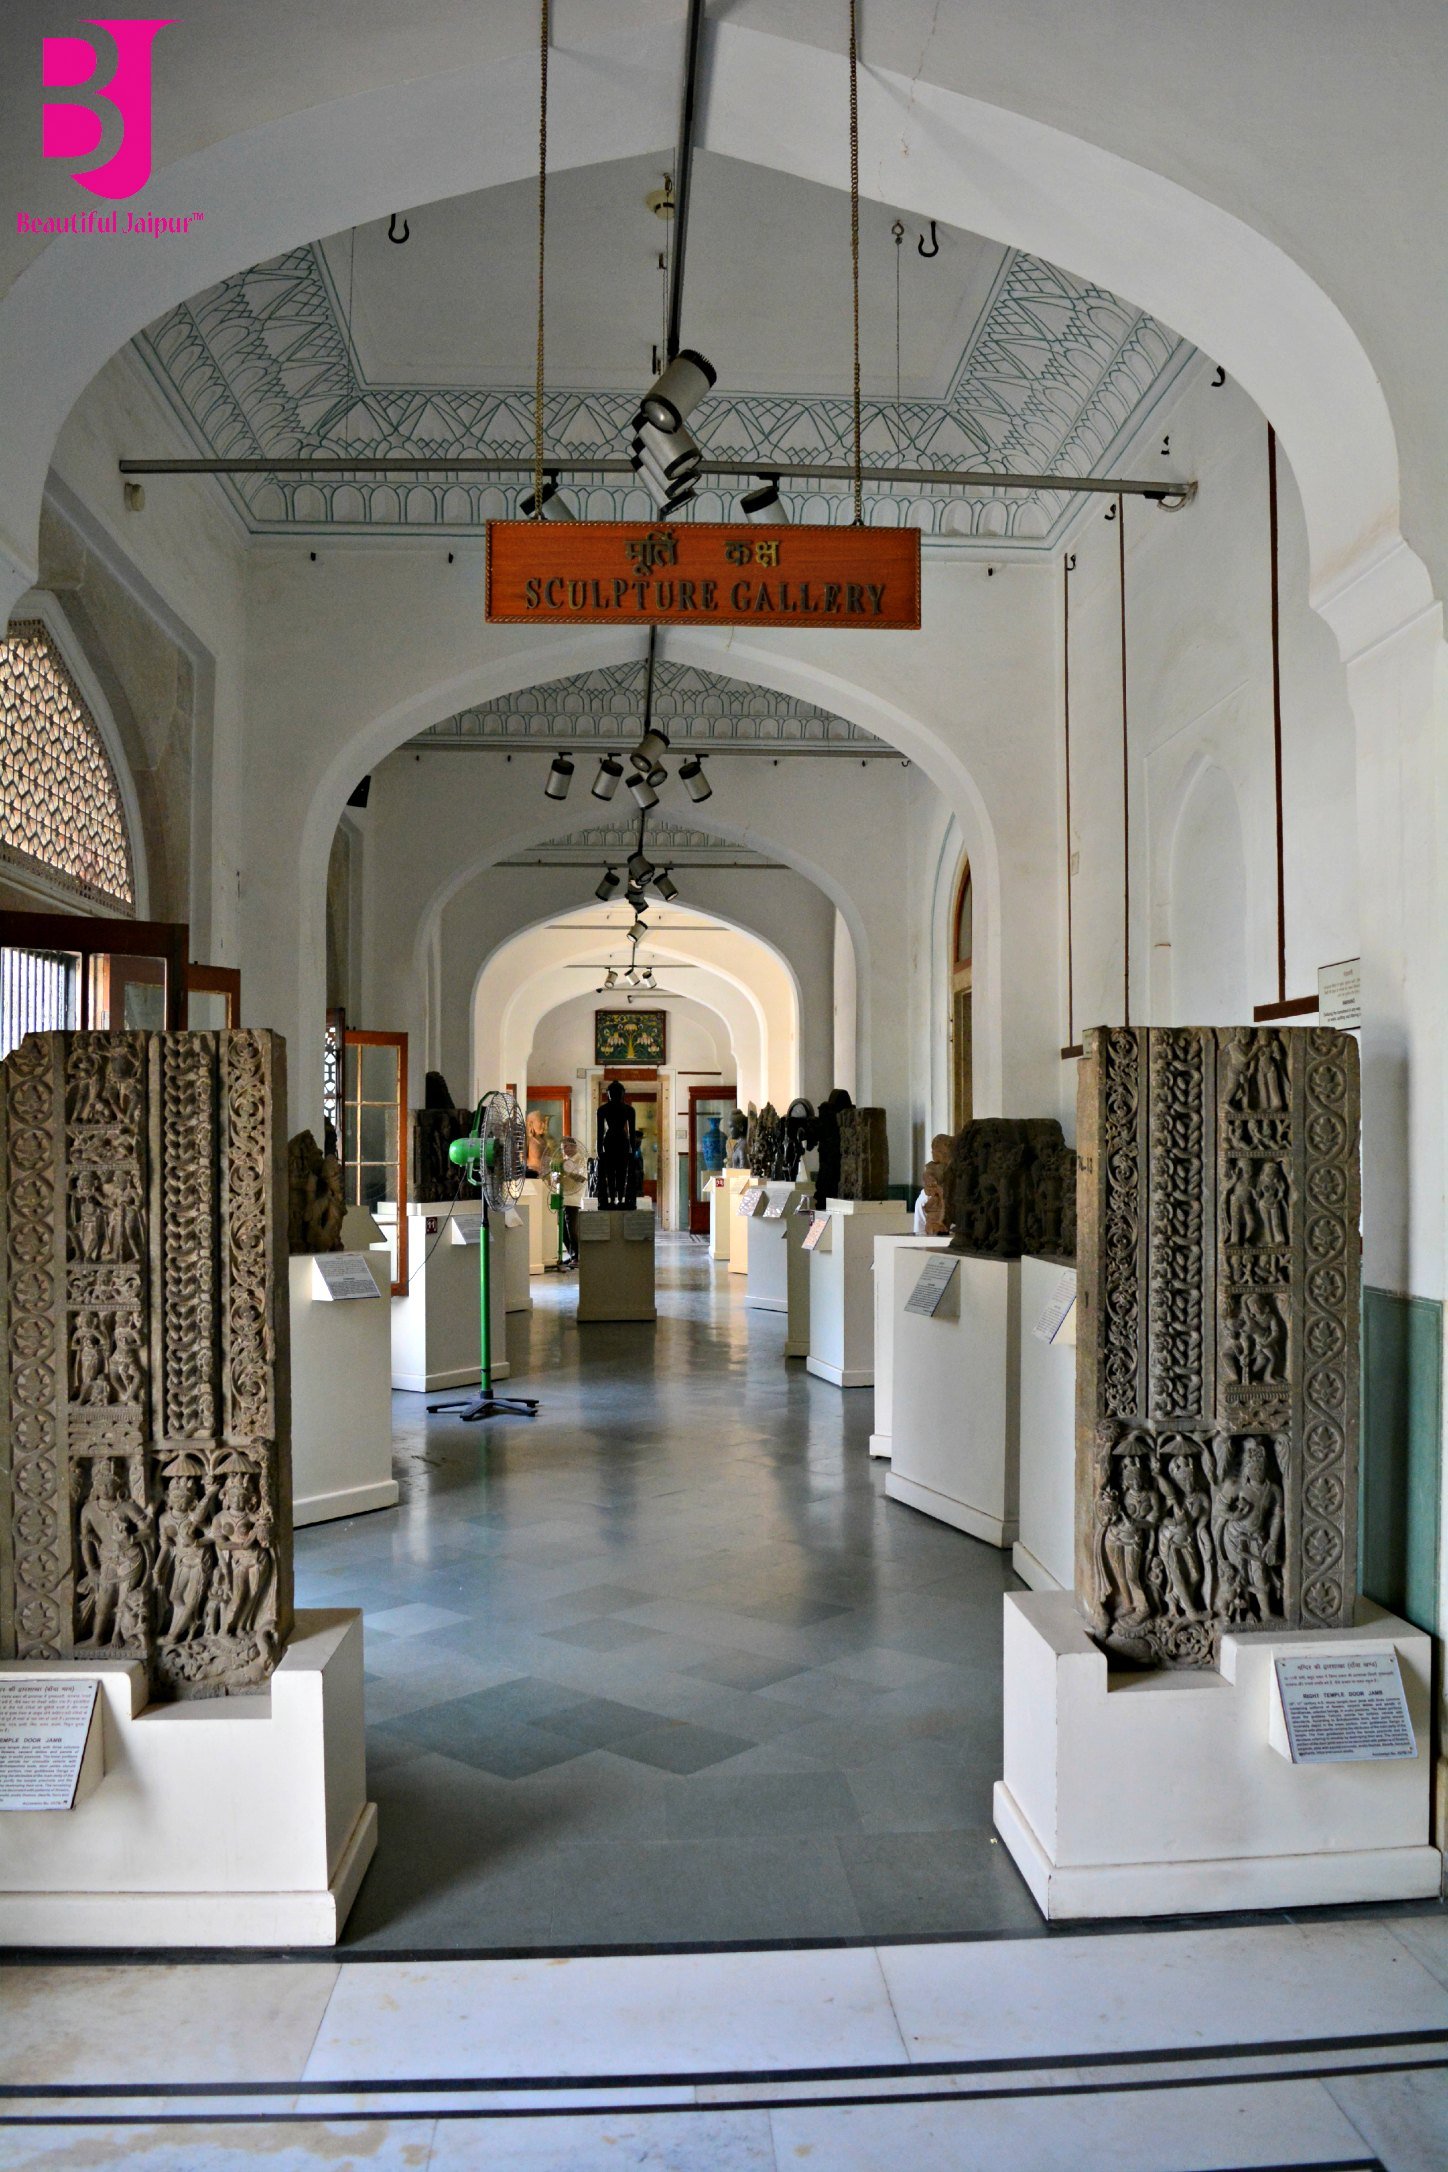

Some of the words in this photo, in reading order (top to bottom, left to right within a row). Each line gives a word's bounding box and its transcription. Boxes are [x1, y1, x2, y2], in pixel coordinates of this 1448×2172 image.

[724, 540, 781, 568] कक्ष
[524, 576, 719, 611] SCULPTURE
[730, 580, 886, 615] GALLERY
